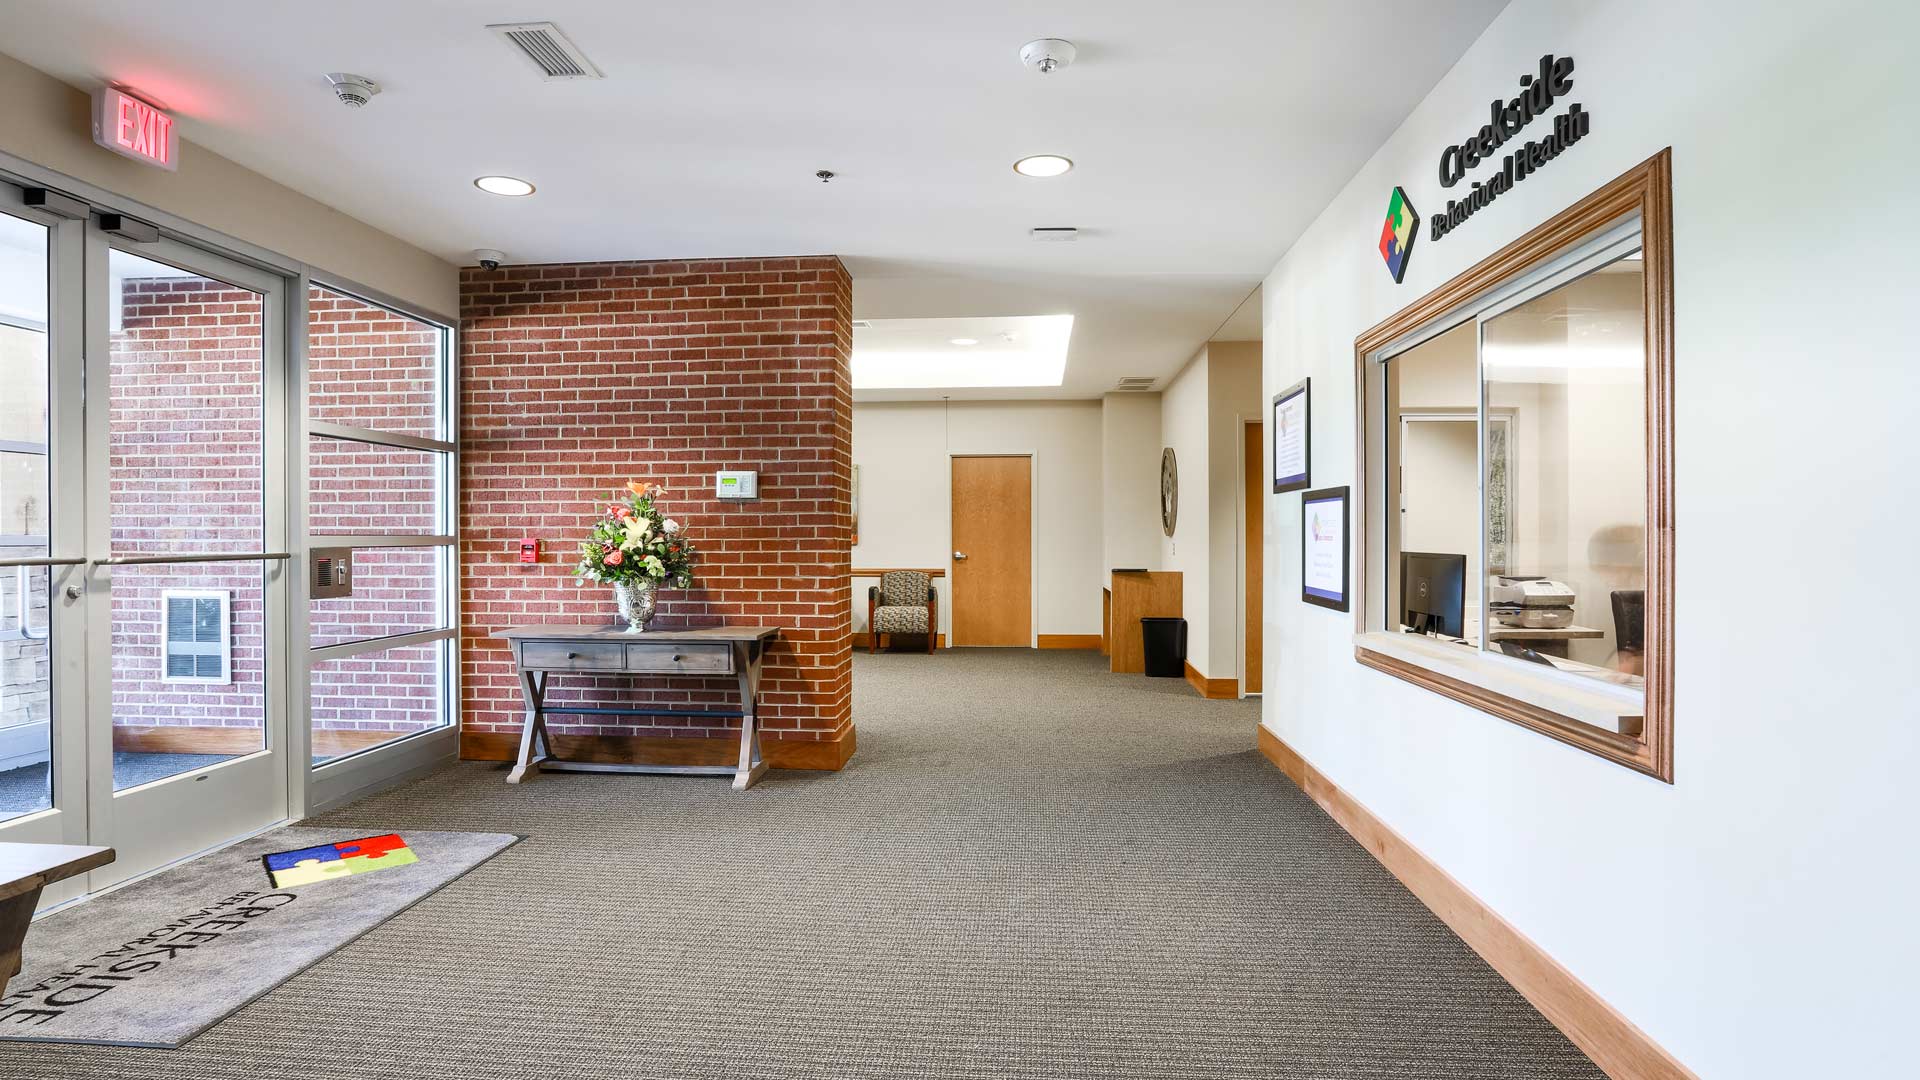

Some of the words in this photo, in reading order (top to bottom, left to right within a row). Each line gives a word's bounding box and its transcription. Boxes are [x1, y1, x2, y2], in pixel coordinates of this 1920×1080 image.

[117, 95, 173, 164] EXIT
[1439, 54, 1575, 188] Creekside
[1430, 155, 1514, 242] Behavioral
[1514, 102, 1590, 182] Health
[0, 893, 298, 1026] CREEKSIDE
[91, 891, 260, 960] BEHAVIORAL
[0, 963, 100, 1011] HEALT
